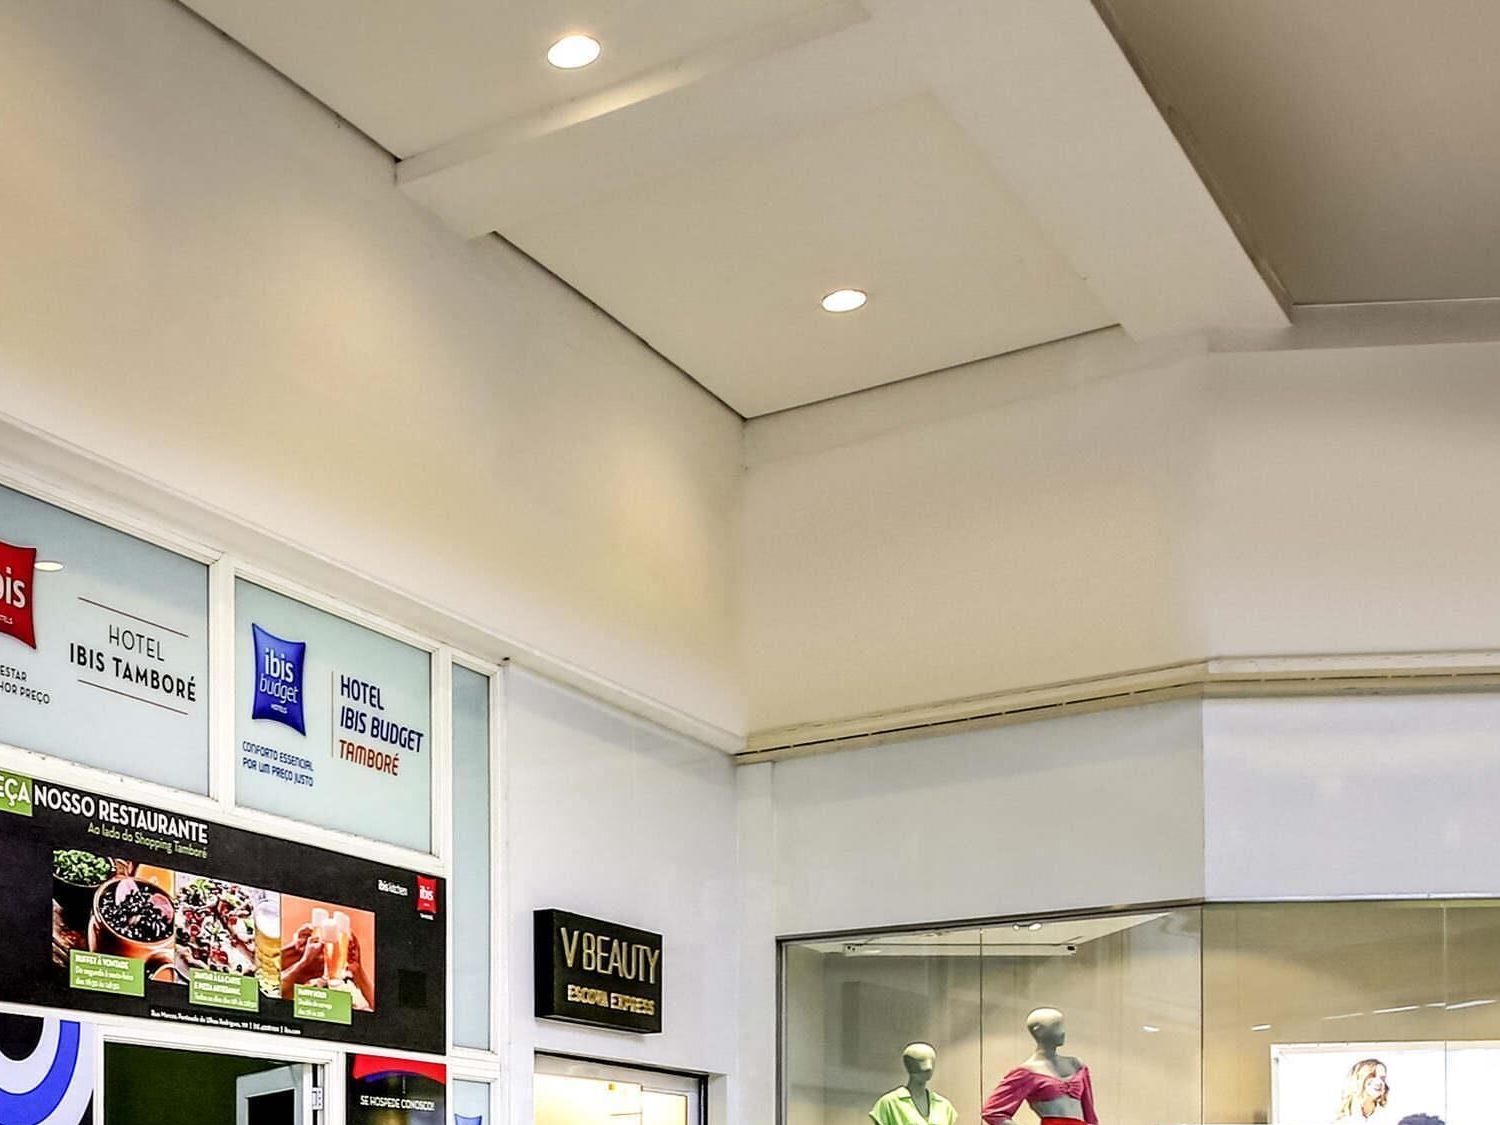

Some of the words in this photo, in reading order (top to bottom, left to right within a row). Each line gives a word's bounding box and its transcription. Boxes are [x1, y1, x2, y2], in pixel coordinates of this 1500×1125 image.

[108, 624, 165, 662] HOTEL
[69, 643, 106, 673] IBIS
[112, 656, 197, 702] TAMBORÉ
[265, 647, 294, 683] ibis
[19, 686, 50, 705] PREÇO
[260, 672, 299, 704] budget
[340, 674, 385, 711] HOTEL
[340, 705, 367, 735] IBIS
[370, 716, 424, 753] BUDGET
[339, 739, 400, 776] TAMBORÉ
[34, 784, 96, 818] NOSSO
[98, 799, 209, 845] RESTAURANTE
[88, 822, 100, 835] Ao
[102, 823, 121, 840] lado
[121, 829, 133, 842] do
[134, 831, 173, 855] Shopping
[560, 927, 580, 968] V
[582, 932, 660, 984] BEAUTY
[567, 984, 609, 1008] ESCOVA
[610, 992, 655, 1016] EXPRESS
